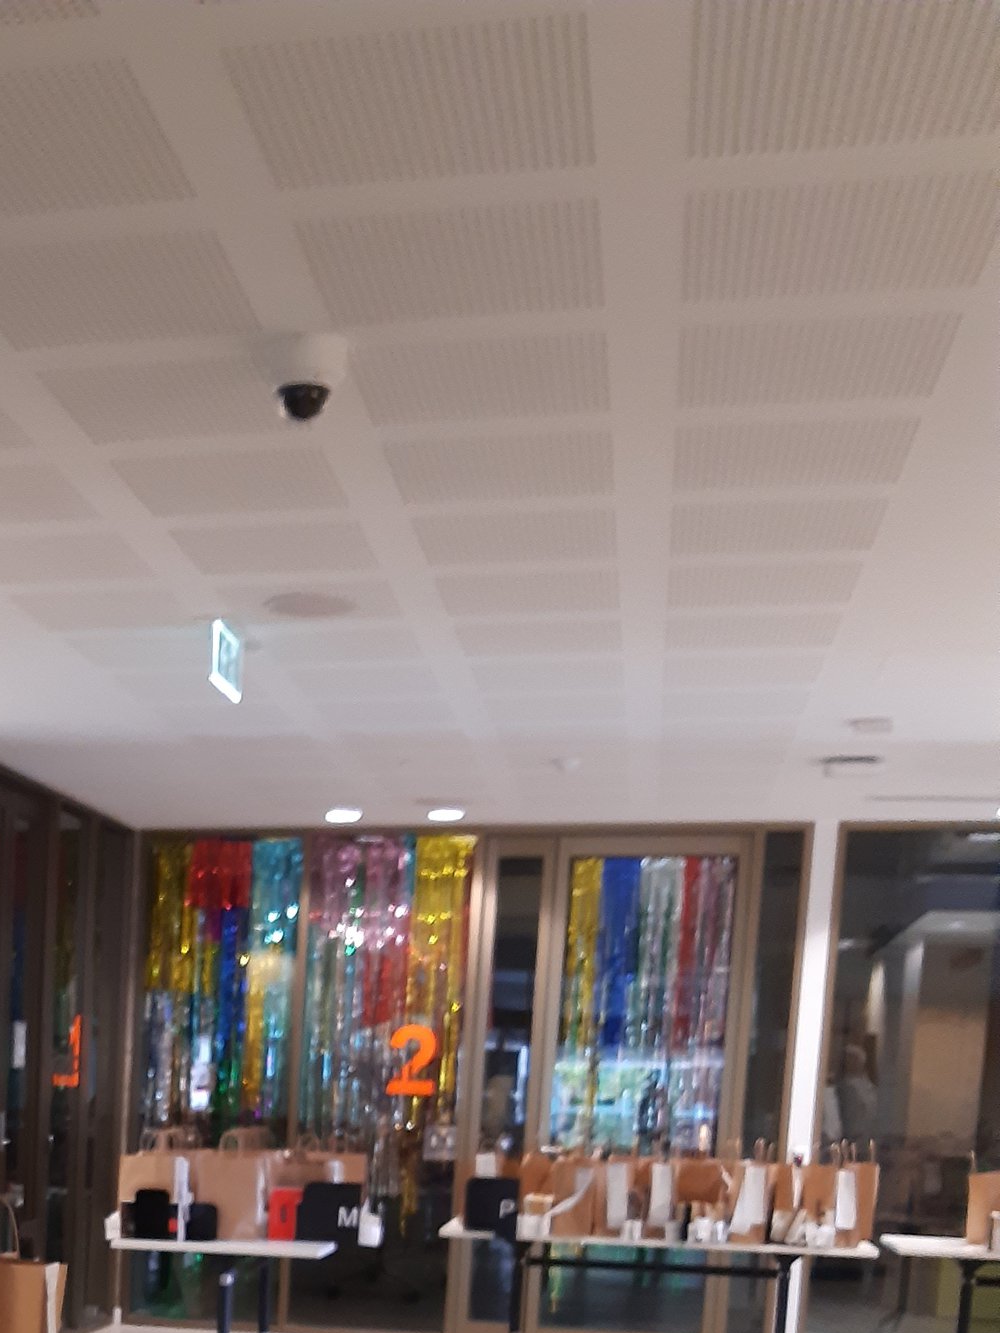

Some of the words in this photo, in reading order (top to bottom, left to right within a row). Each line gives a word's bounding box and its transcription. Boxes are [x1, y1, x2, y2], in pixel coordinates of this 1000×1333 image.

[385, 1023, 438, 1096] 2
[337, 1205, 359, 1228] M
[499, 1199, 516, 1219] P
